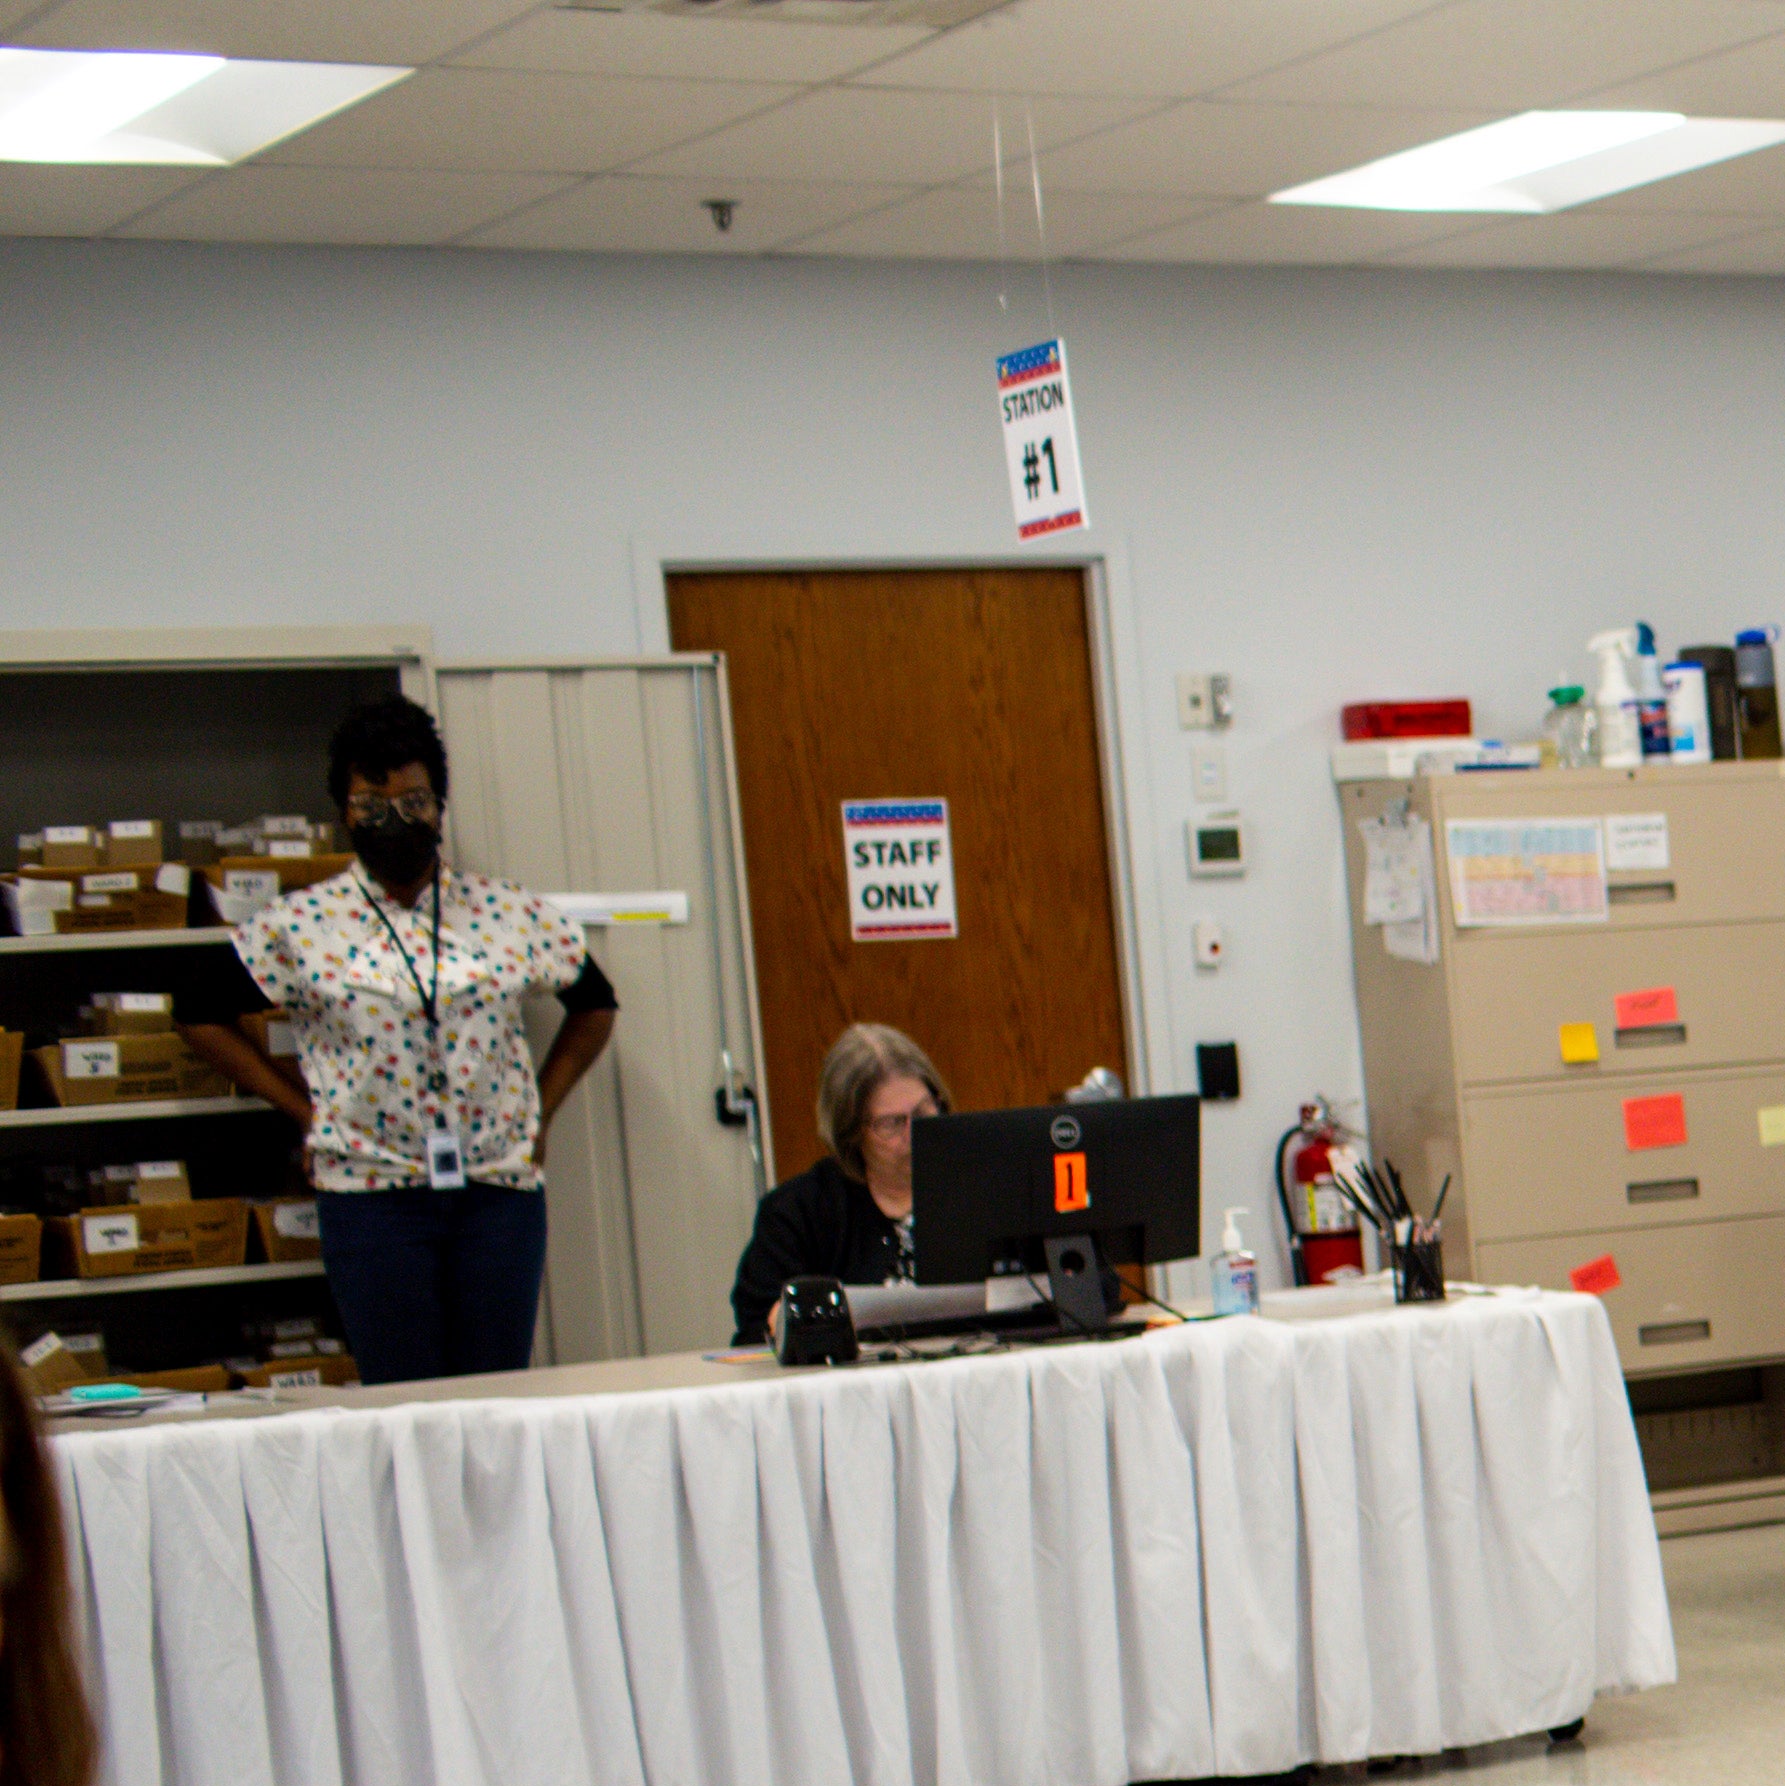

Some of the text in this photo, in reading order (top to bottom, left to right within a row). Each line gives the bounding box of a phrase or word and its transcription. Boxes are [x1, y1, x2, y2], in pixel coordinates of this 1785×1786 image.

[1003, 381, 1064, 423] STATION
[1023, 436, 1059, 500] #1
[854, 840, 941, 867] STAFF
[861, 882, 939, 910] ONLY
